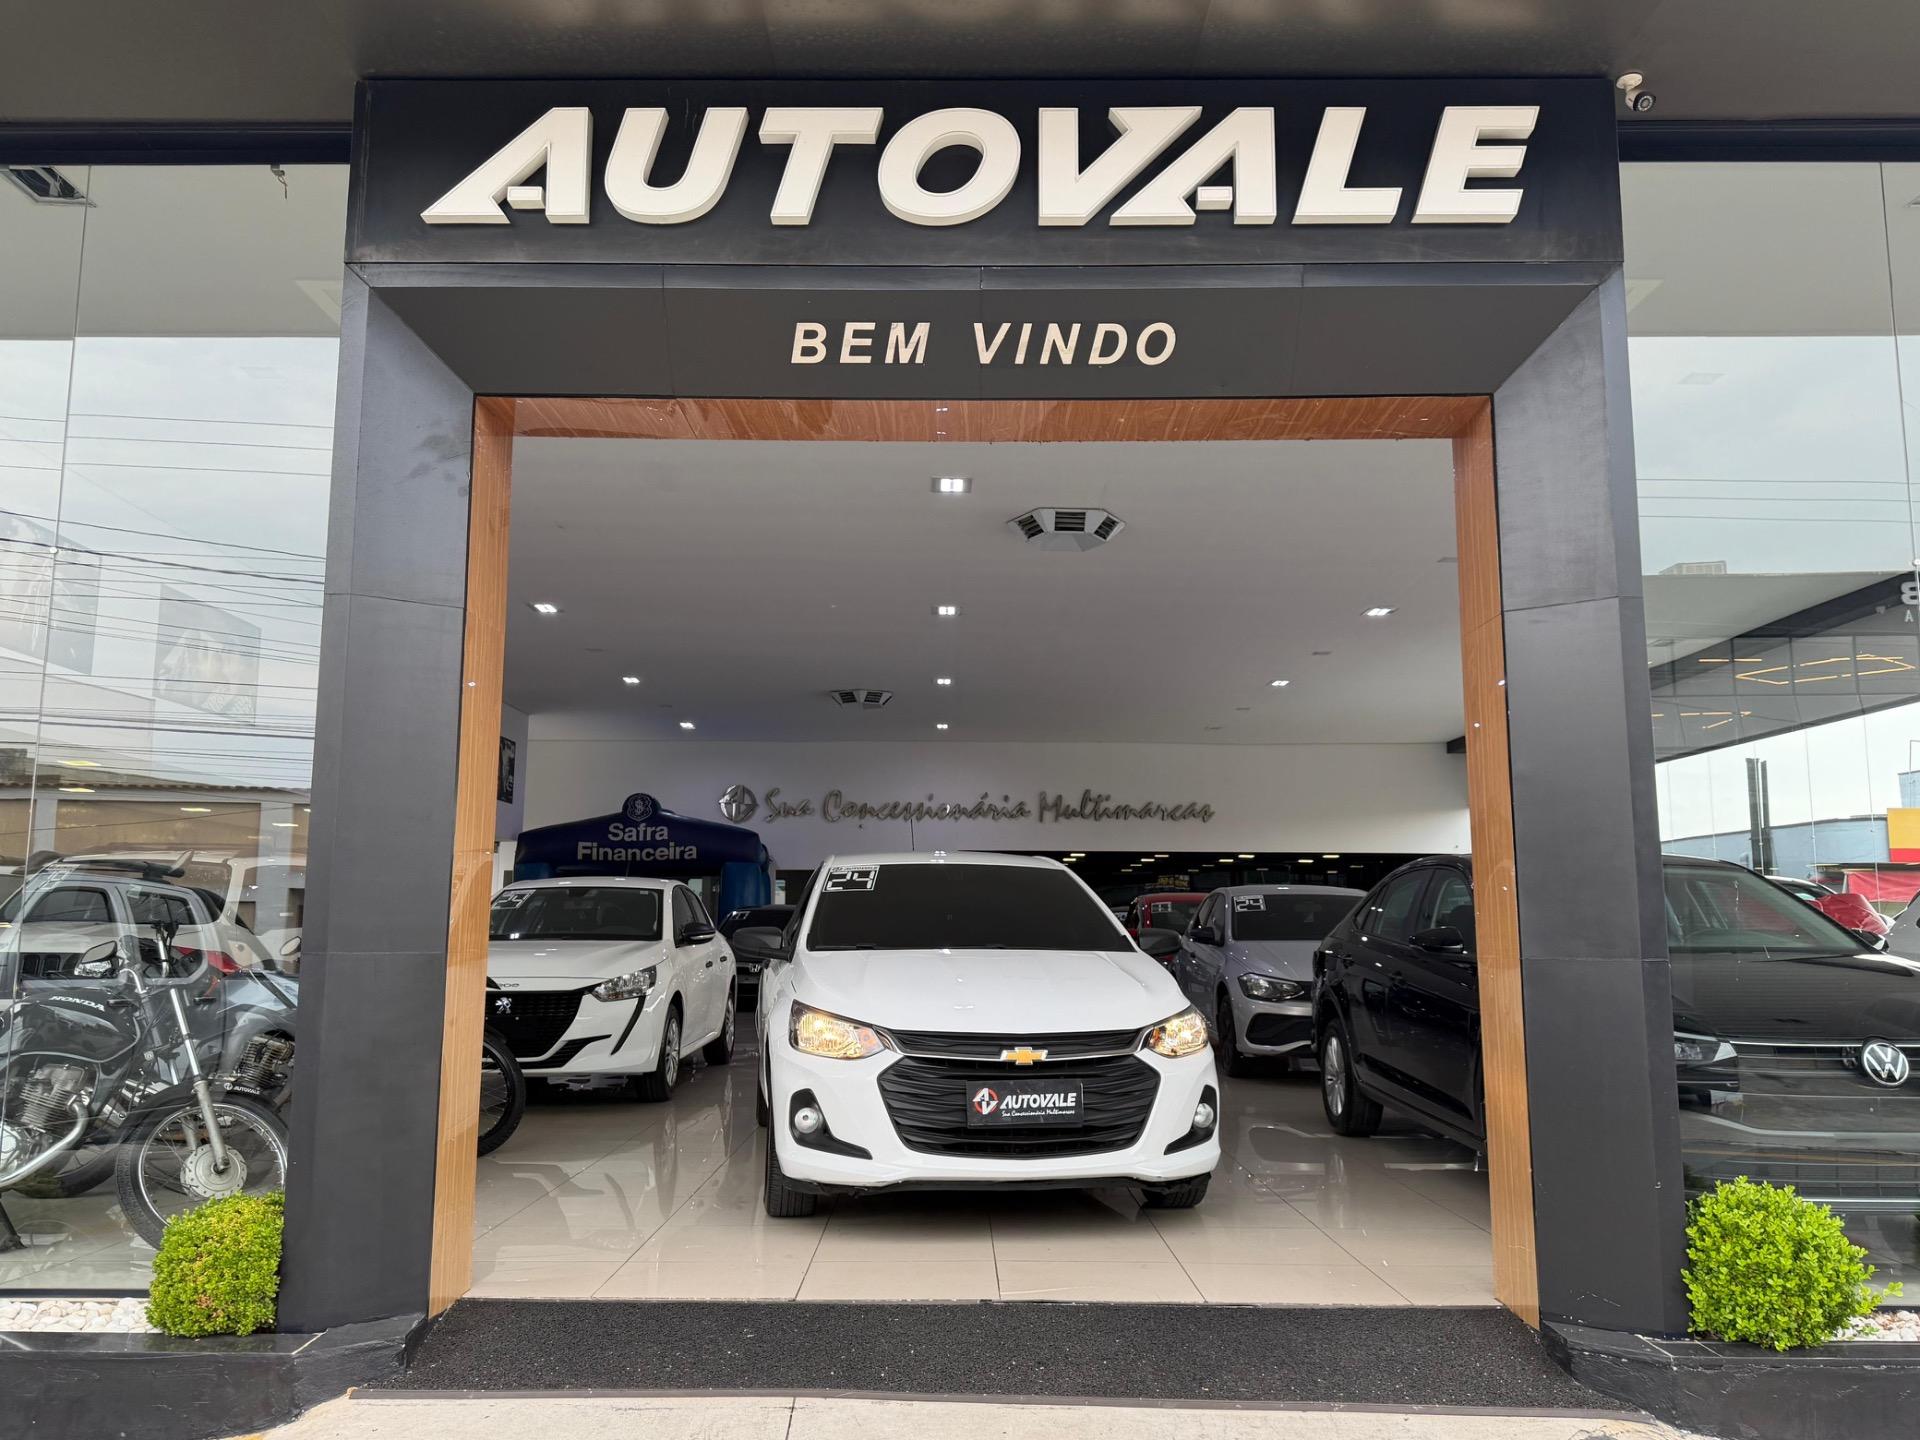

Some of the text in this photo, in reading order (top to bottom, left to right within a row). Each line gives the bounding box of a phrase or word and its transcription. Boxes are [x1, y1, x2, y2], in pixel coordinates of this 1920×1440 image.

[421, 106, 1540, 226] AUTOVALE
[791, 322, 1177, 366] BEM VINDO
[764, 788, 1216, 824] Sua Concessionária Multimarcas
[608, 822, 669, 841] Safra
[577, 841, 698, 861] Financeira
[827, 871, 876, 890] 24
[1236, 898, 1265, 912] 24
[48, 995, 105, 1012] HONDA
[233, 1085, 261, 1095] AUTOVALE
[1000, 1092, 1077, 1109] AUTOVALE
